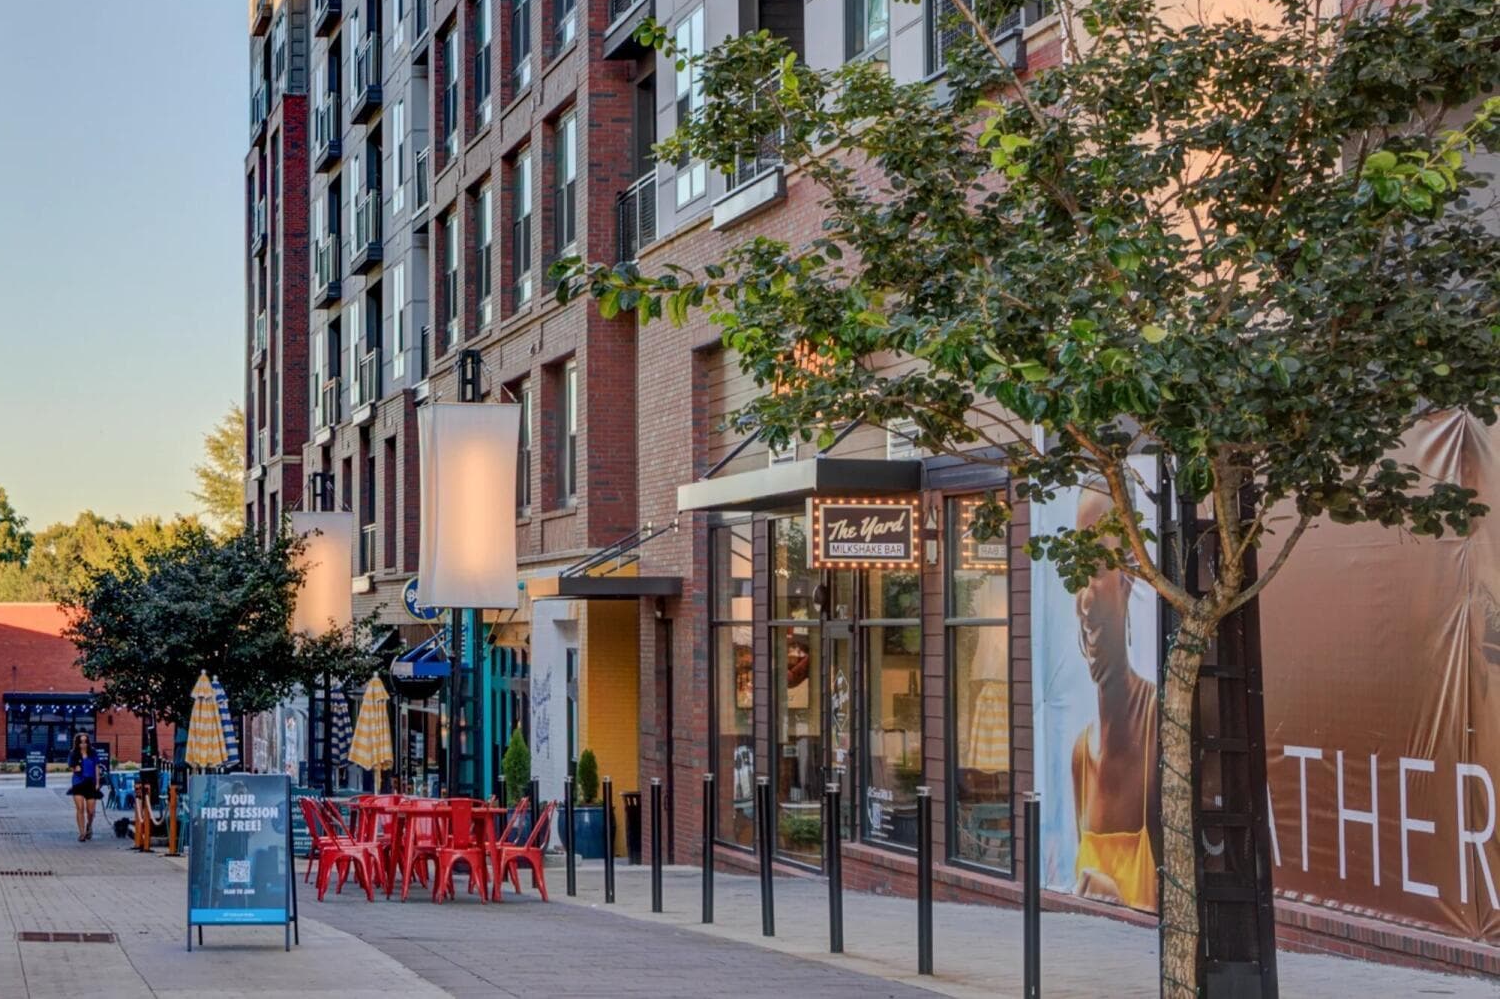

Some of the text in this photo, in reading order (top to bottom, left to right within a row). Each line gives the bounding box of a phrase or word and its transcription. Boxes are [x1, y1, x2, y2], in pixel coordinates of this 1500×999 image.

[828, 510, 905, 542] The Yard
[831, 542, 903, 556] MILKSHAKE BAR
[223, 794, 256, 806] YOUR
[200, 807, 231, 819] FIRST
[233, 807, 279, 819] SESSION
[217, 820, 262, 832] IS FREE!
[1266, 745, 1500, 911] THER
